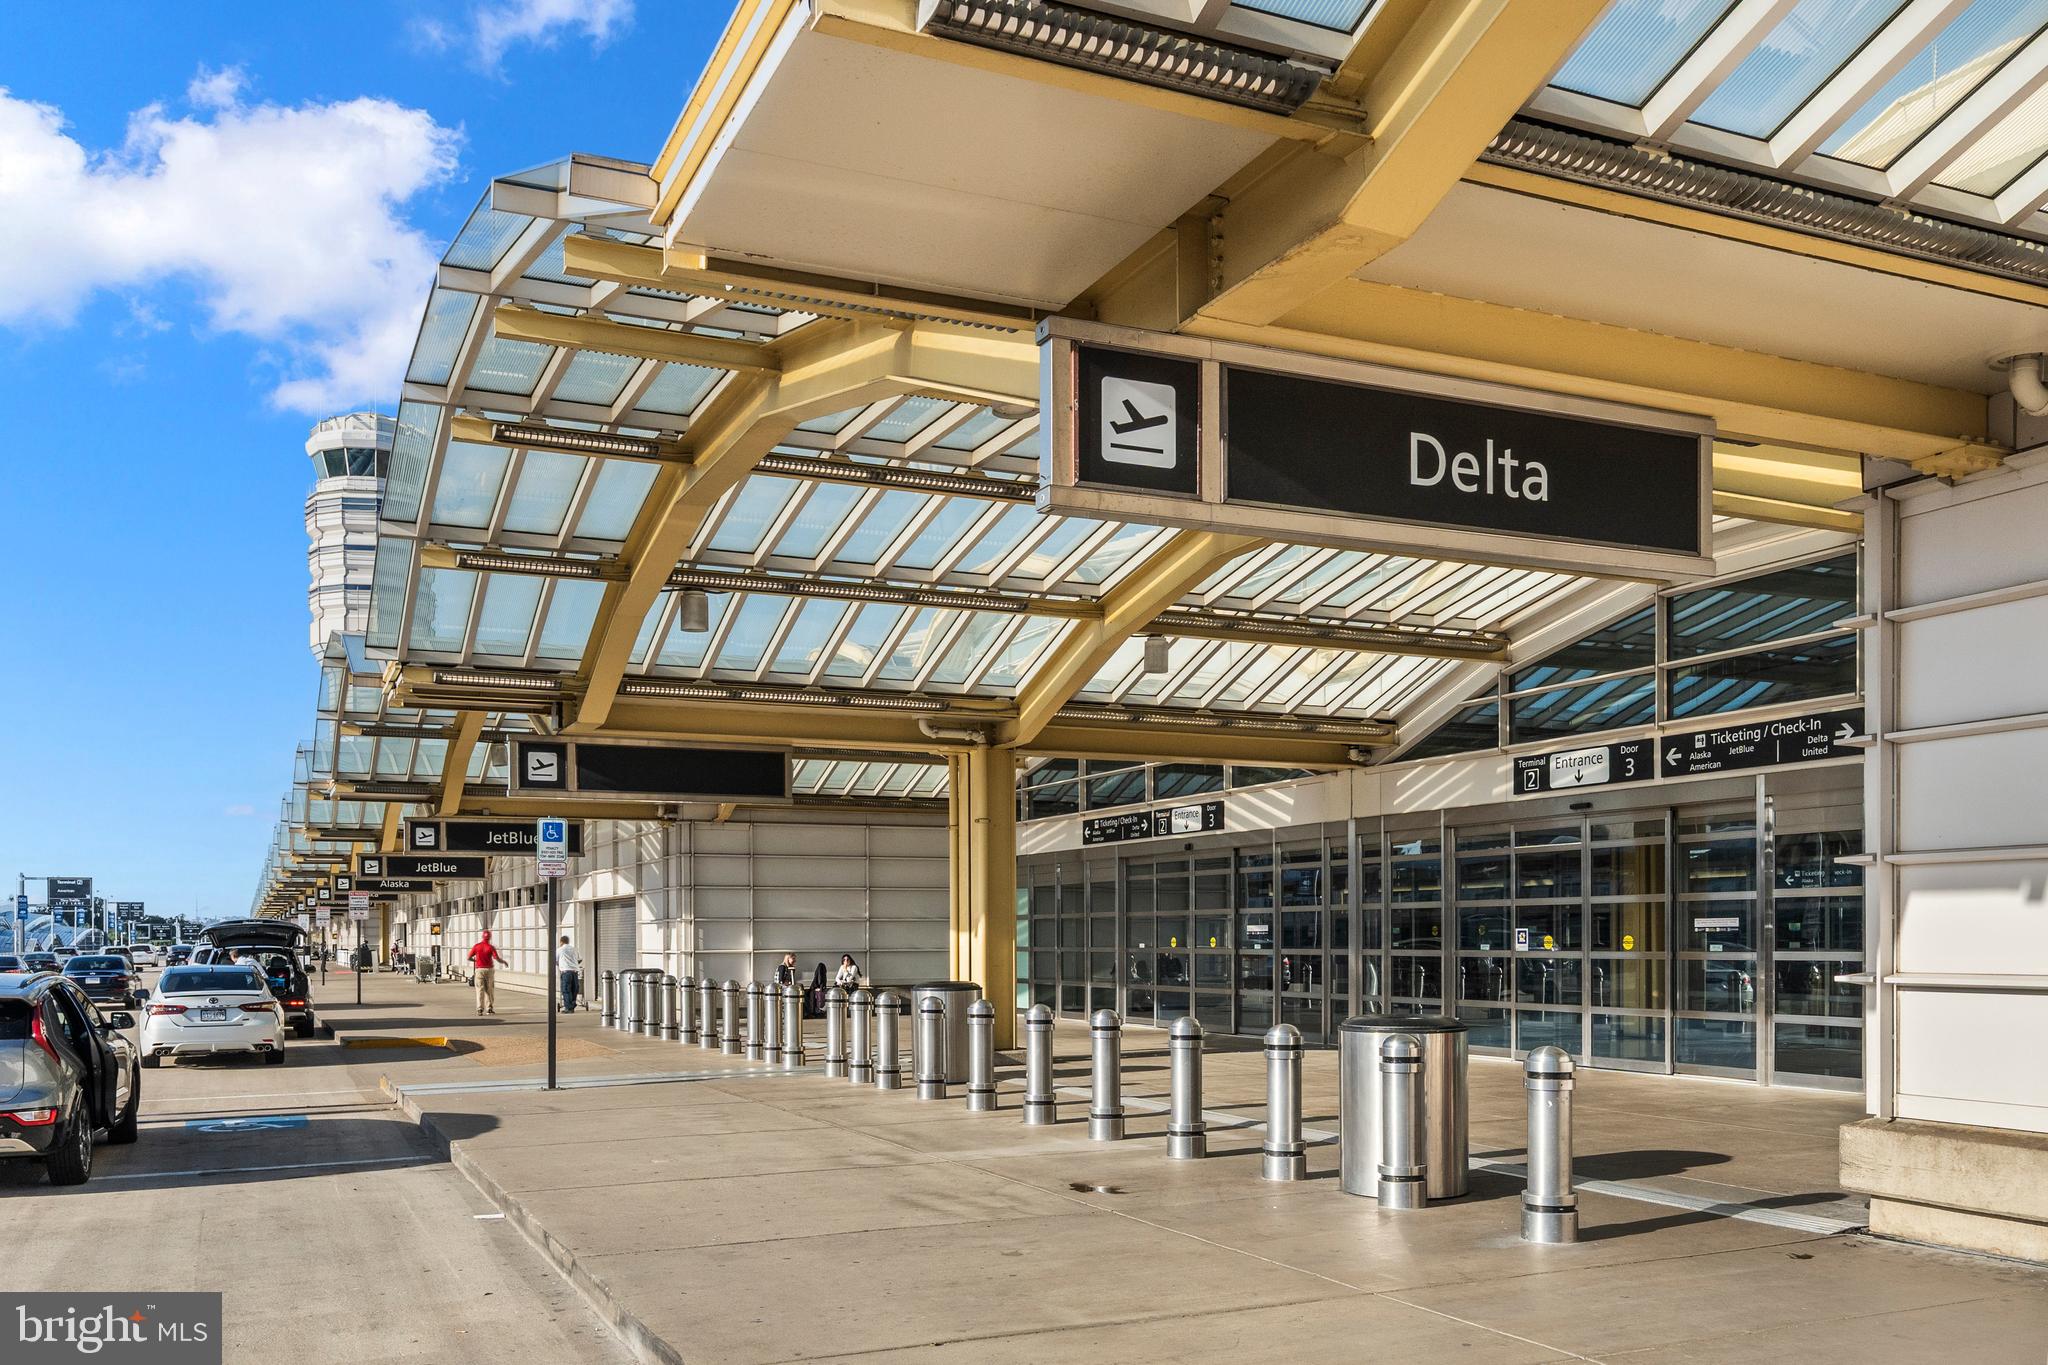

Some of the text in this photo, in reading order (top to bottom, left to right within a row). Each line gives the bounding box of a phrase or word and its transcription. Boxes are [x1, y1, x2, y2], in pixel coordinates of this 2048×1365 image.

[1410, 432, 1548, 501] Delta
[1711, 718, 1822, 745] Ticketing / Check-In
[1807, 734, 1828, 744] Delta
[1620, 745, 1639, 755] Door
[1728, 745, 1755, 756] JetBlue
[1802, 746, 1828, 757] United
[1555, 753, 1604, 770] Entrance
[1689, 751, 1712, 761] Alaska
[1518, 757, 1546, 769] Terminal
[1625, 758, 1635, 777] 3
[1689, 761, 1722, 772] American
[1528, 771, 1536, 788] 2
[1174, 810, 1199, 820] Entrance
[1209, 813, 1215, 827] 3
[1100, 818, 1118, 827] Ticketing
[415, 863, 457, 873] JetBlue
[380, 880, 409, 888] Alaska
